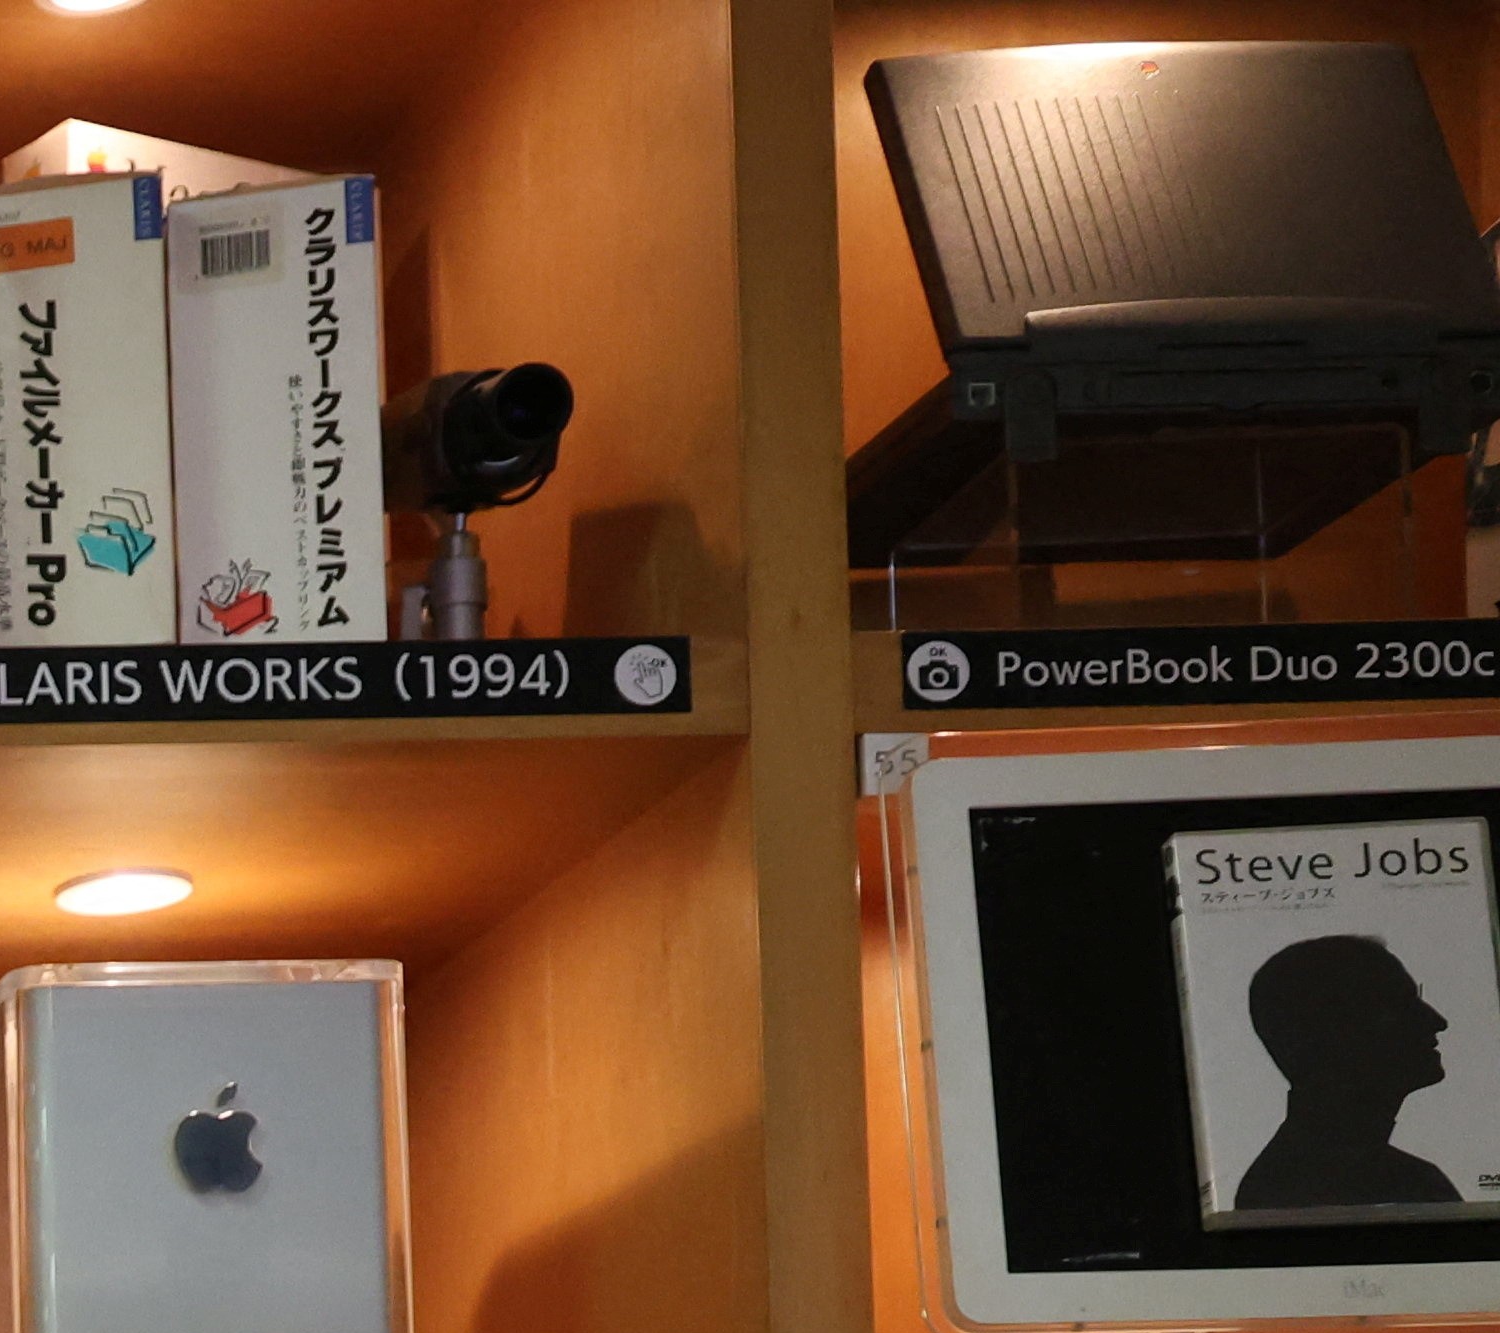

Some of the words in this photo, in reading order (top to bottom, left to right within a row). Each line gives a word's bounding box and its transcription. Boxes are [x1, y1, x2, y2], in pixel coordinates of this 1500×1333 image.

[134, 178, 154, 239] CLARIS
[18, 301, 66, 544] ファイルメーカー
[26, 553, 67, 628] Pro
[161, 655, 364, 706] WORKS
[394, 651, 572, 706] (1994)
[997, 645, 1234, 688] PowerBook
[1250, 645, 1340, 684] Duo
[1355, 640, 1497, 681] 2300c
[875, 749, 919, 778] 55
[1196, 847, 1333, 885] Steve
[1354, 837, 1469, 879] Jobs
